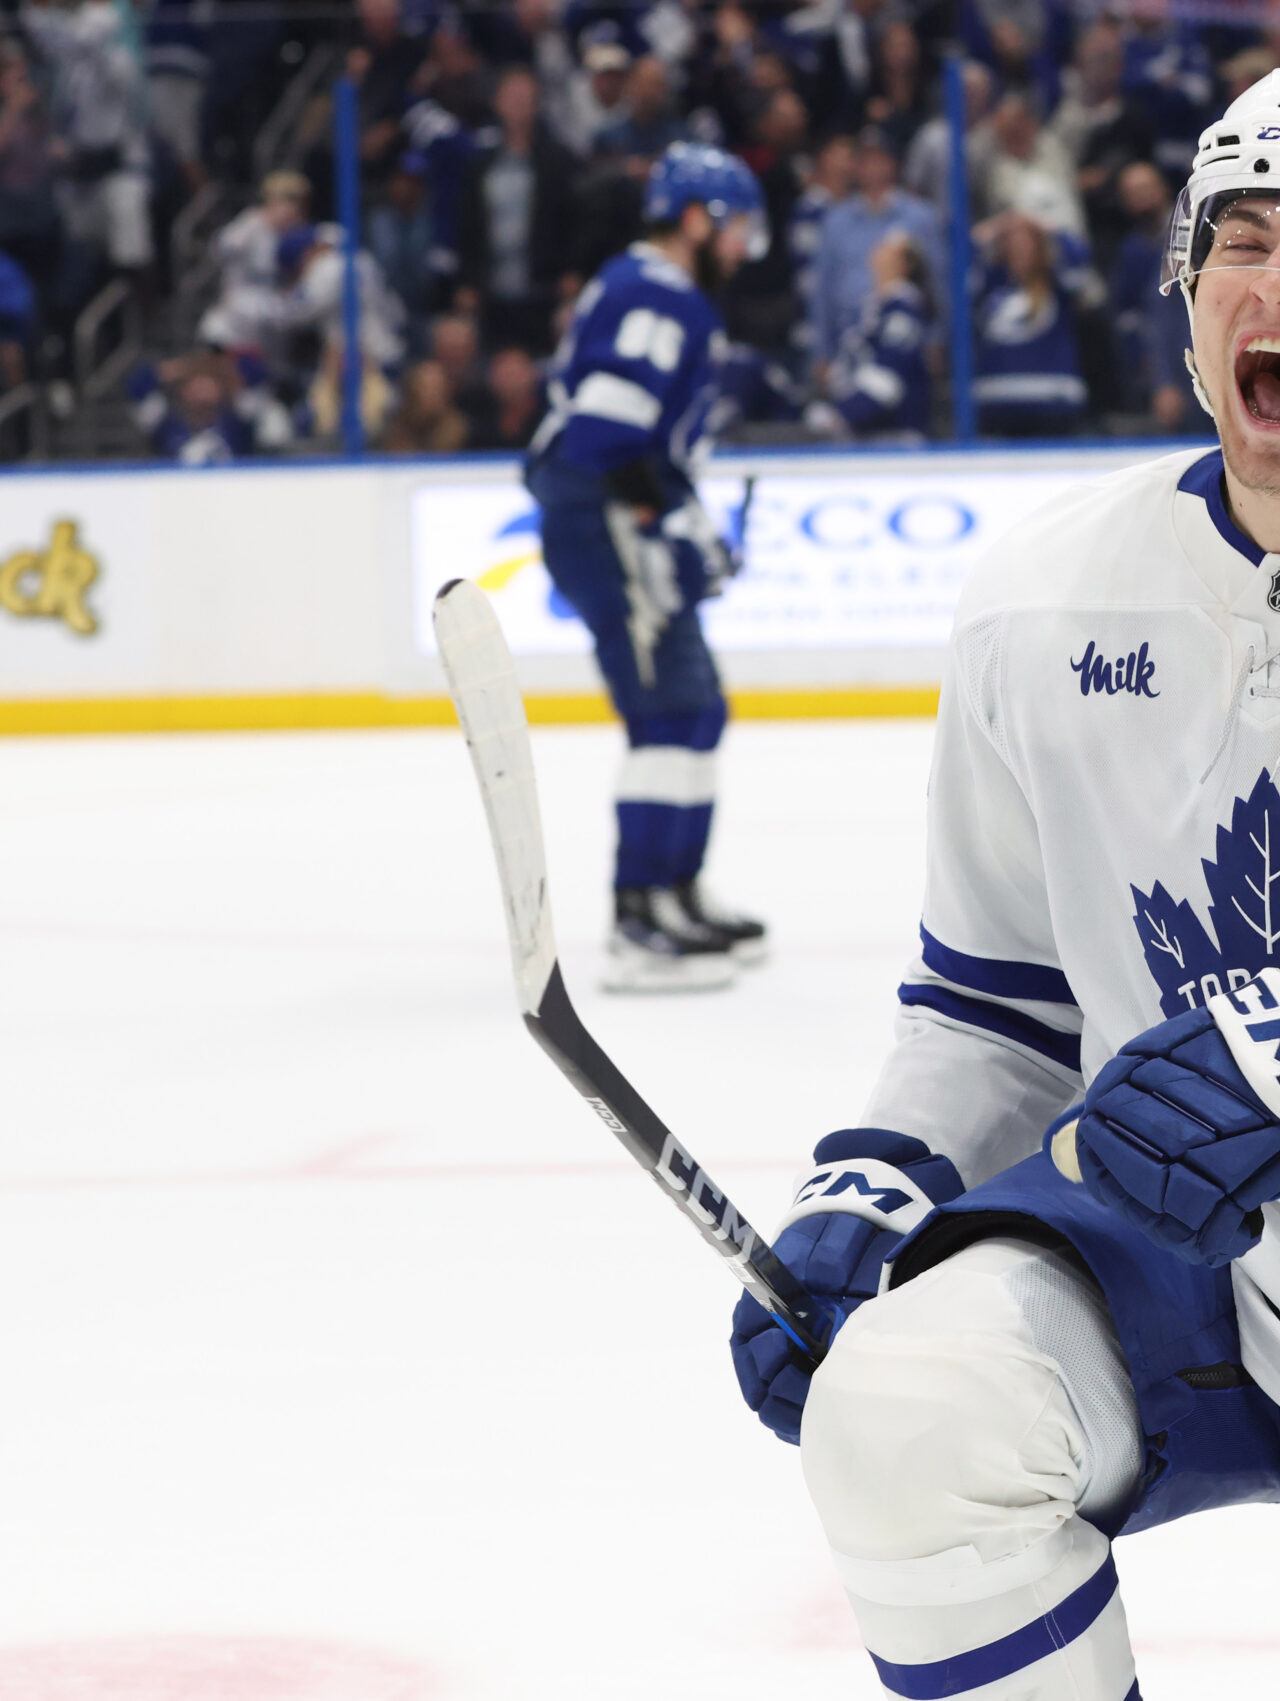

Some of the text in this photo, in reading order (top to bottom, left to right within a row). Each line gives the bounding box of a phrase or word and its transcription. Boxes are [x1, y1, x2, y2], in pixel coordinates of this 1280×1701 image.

[724, 496, 978, 552] ECO
[1070, 640, 1161, 698] Milk
[655, 1133, 757, 1265] CCM
[793, 1170, 914, 1215] CM
